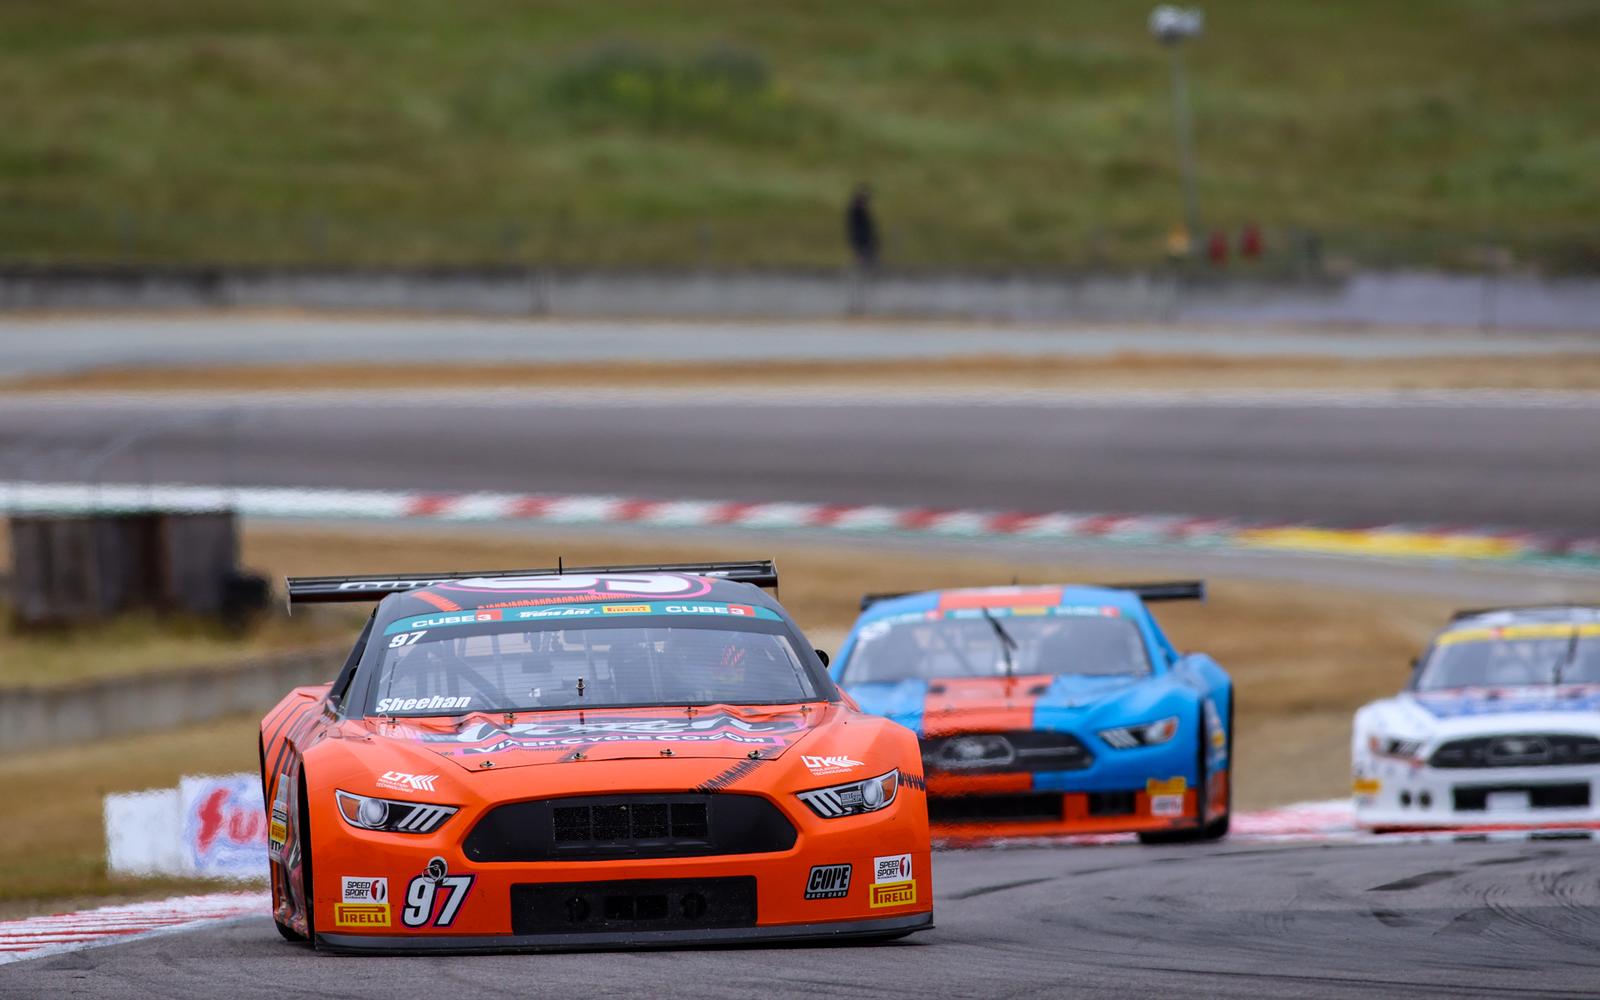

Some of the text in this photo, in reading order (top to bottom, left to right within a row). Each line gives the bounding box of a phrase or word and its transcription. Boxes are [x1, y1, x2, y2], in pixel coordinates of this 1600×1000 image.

[665, 605, 744, 616] CUBE3
[412, 614, 492, 628] CUBE3
[389, 630, 427, 648] 97
[375, 695, 472, 713] Sheehan
[880, 860, 899, 869] SPEED
[809, 867, 850, 890] COPE
[877, 868, 899, 877] SPORT
[347, 881, 371, 889] SPEED
[345, 889, 370, 897] SPORT
[873, 883, 913, 904] PIRELLI
[403, 875, 473, 927] 97
[338, 906, 386, 923] PIRELLI
